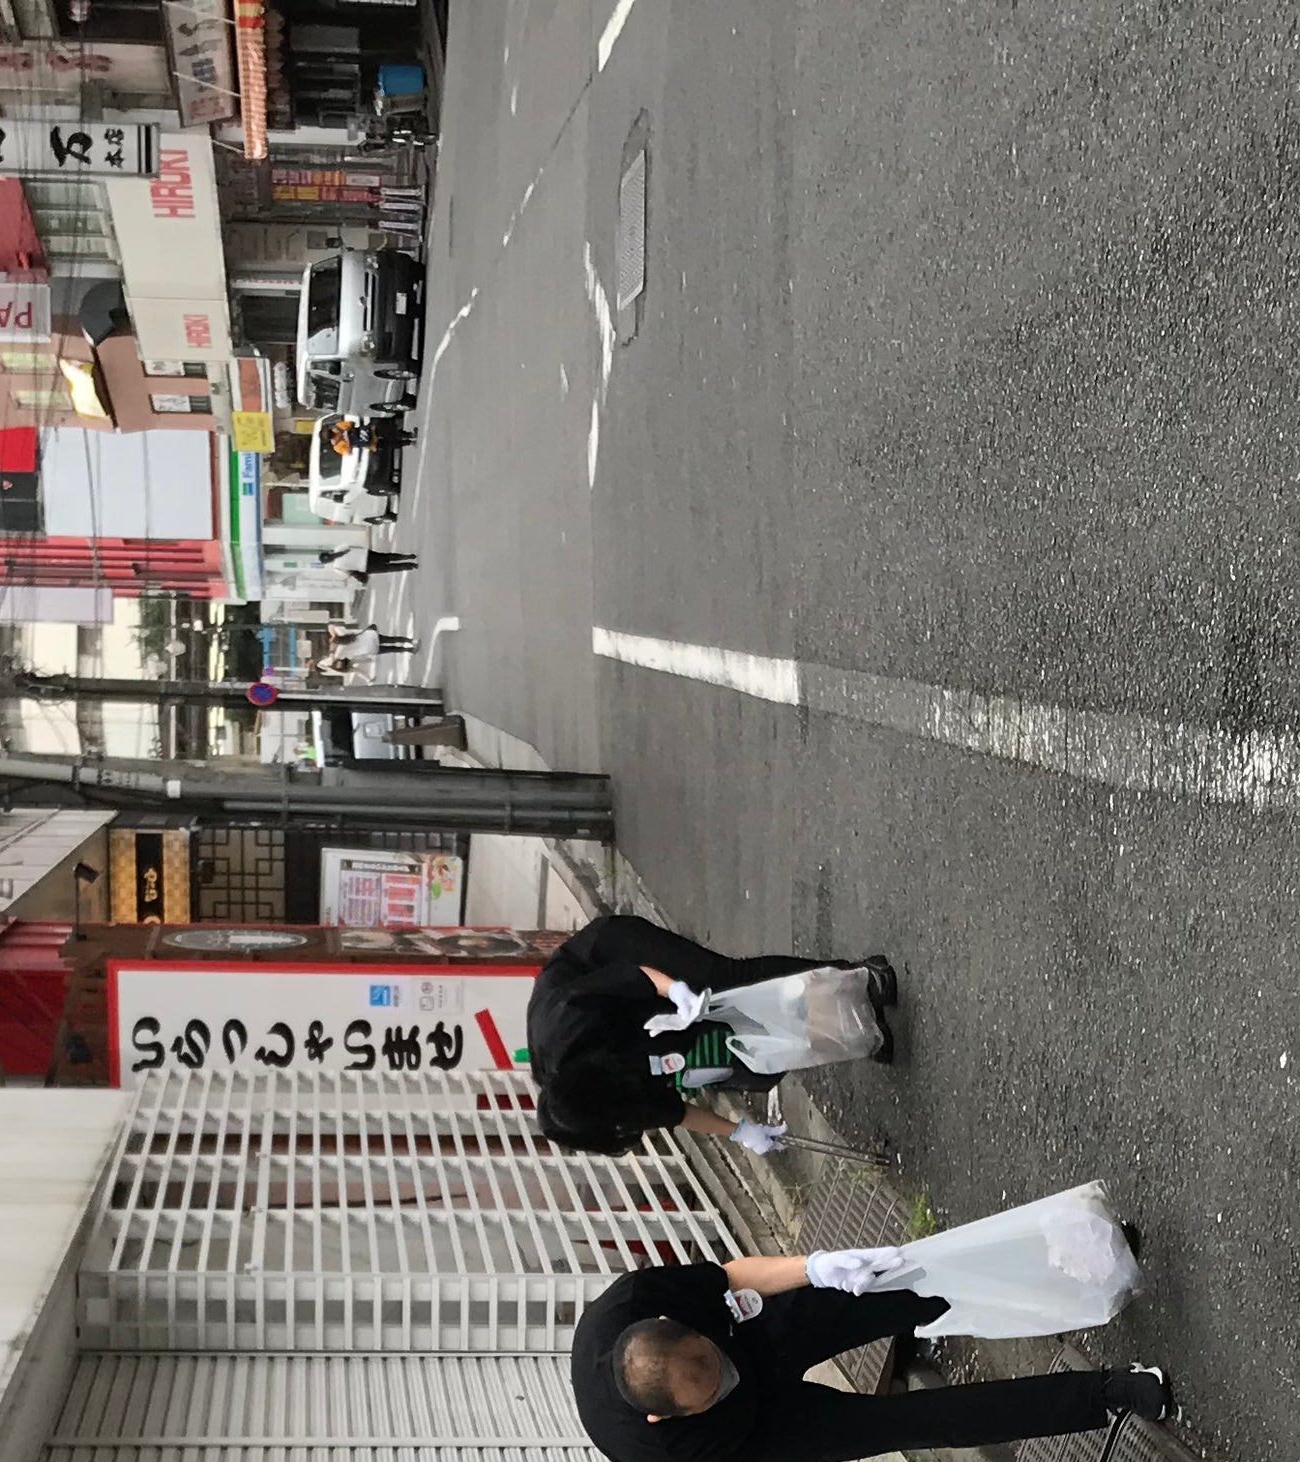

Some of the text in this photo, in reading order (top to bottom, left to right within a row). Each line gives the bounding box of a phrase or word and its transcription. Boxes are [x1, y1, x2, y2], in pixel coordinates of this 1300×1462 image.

[104, 128, 125, 168] 本店
[150, 149, 196, 218] HIROKI
[183, 314, 212, 348] HIROKI
[131, 1016, 464, 1073] いらっしゃいませ
